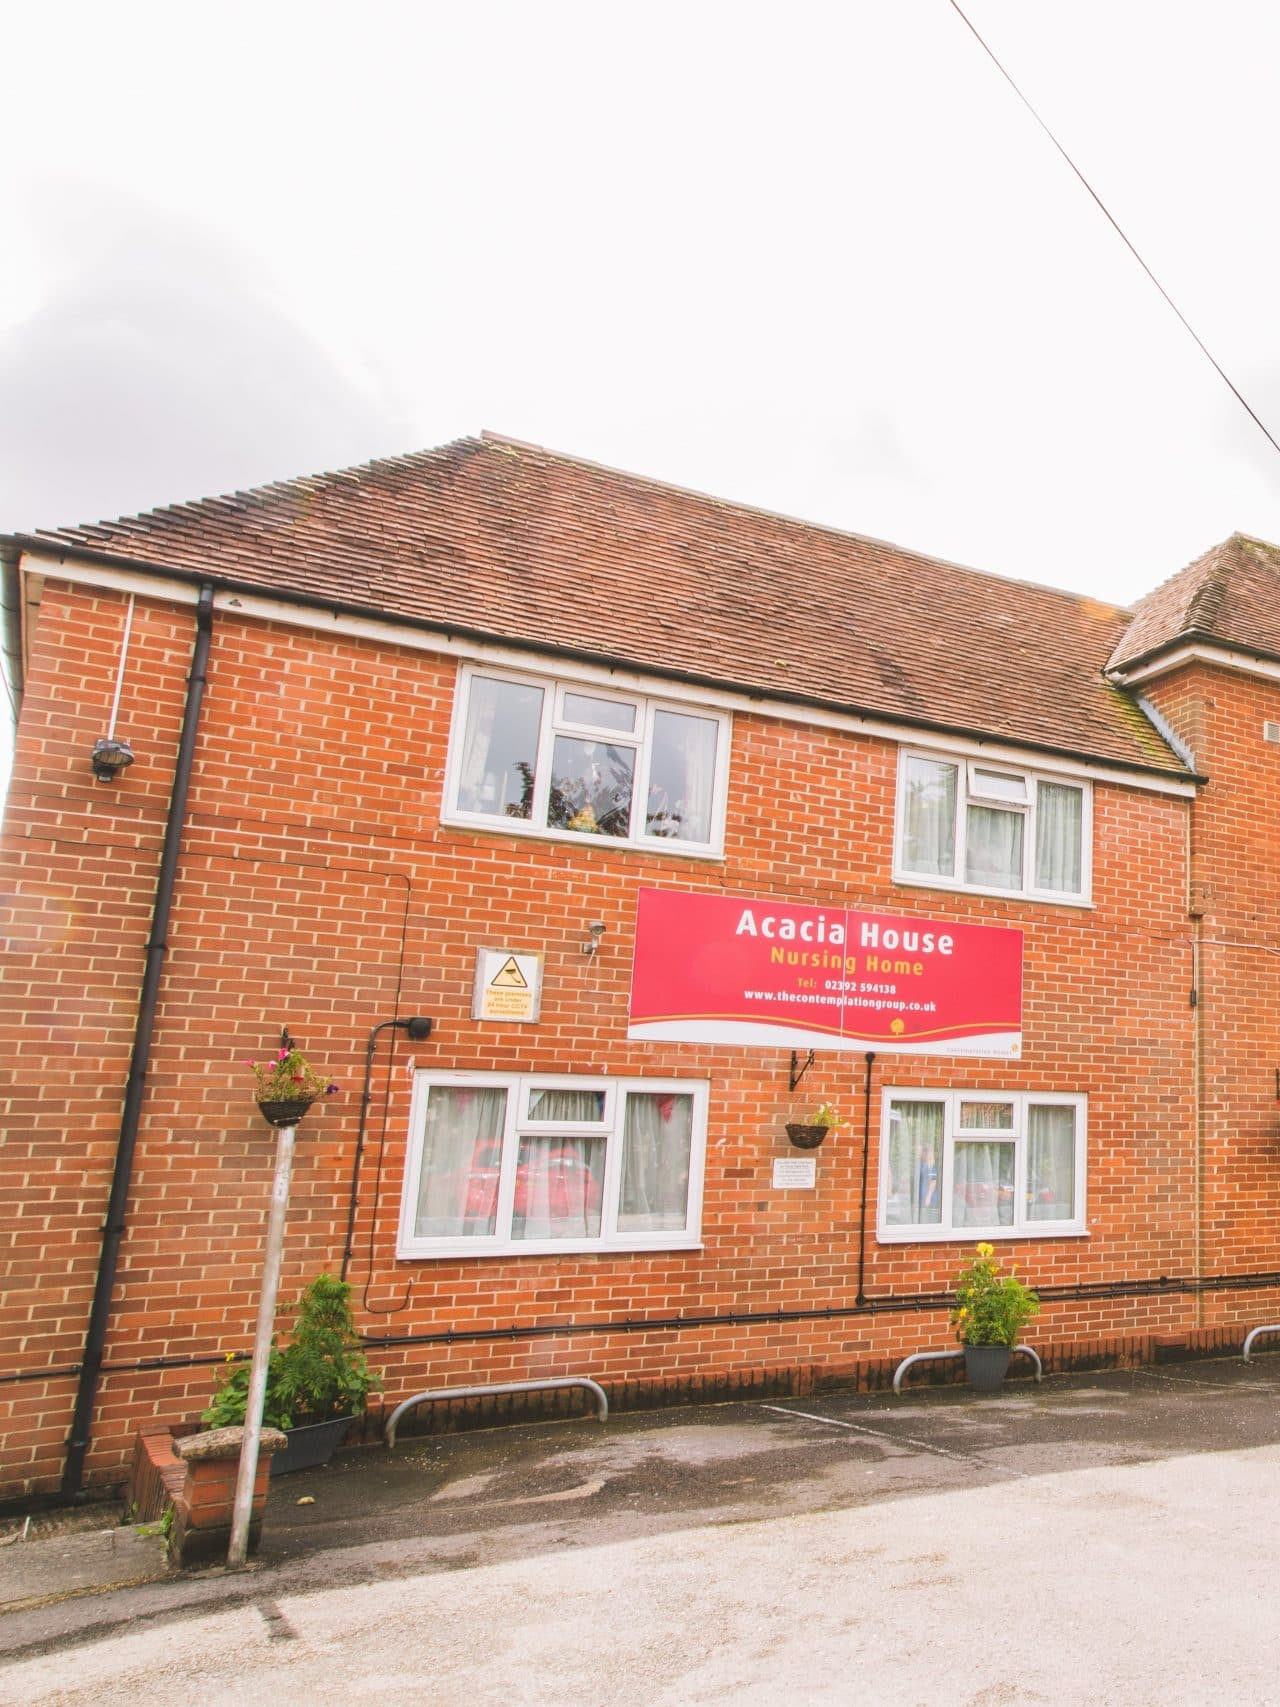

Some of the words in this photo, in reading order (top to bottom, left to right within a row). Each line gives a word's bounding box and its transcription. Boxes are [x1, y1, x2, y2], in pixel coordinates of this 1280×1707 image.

[736, 909, 845, 945] Acacia
[860, 921, 954, 955] House
[770, 946, 856, 974] Nursing
[866, 955, 924, 976] Home
[798, 977, 817, 988] Tel:
[825, 979, 857, 992] 02392
[860, 982, 896, 995] 594138
[744, 989, 937, 1012] www.thecontemplationgroup.co.uk
